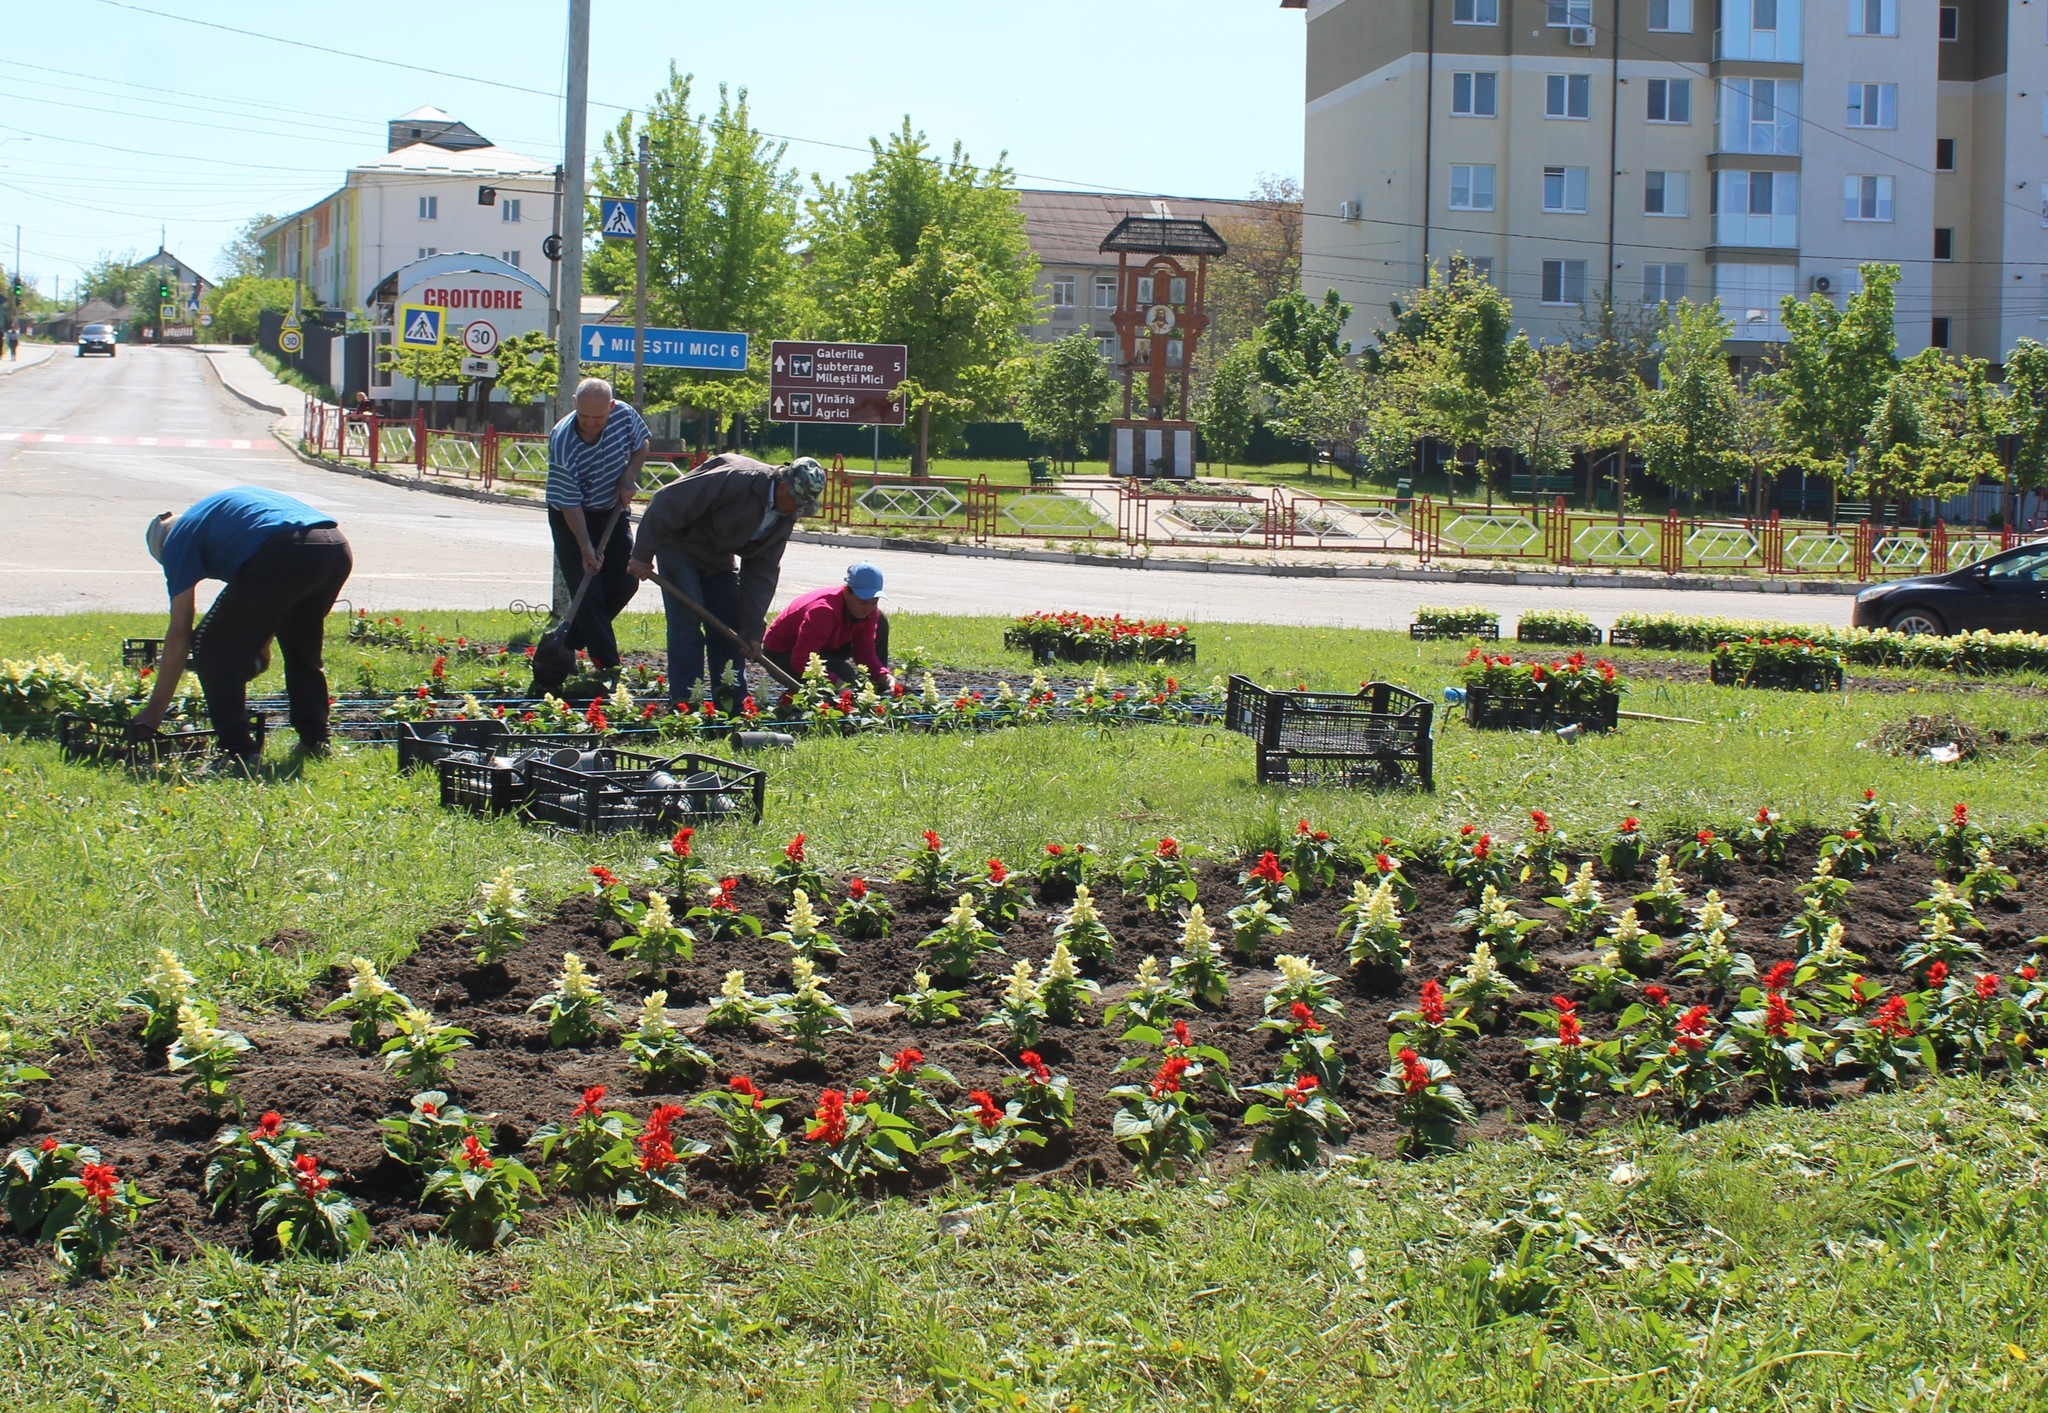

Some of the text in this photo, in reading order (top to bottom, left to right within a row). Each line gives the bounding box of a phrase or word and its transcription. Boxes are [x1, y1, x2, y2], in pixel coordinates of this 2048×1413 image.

[424, 288, 522, 309] CROITORIE
[286, 336, 298, 346] 30
[471, 329, 490, 345] 30
[689, 343, 725, 357] MICI
[730, 345, 740, 358] 6
[816, 348, 865, 359] Galeriile
[816, 362, 874, 373] subterane
[893, 362, 901, 372] 5
[861, 374, 884, 384] Mici
[816, 393, 855, 404] Vinăria
[892, 402, 900, 413] 6
[815, 408, 850, 420] Agrici
